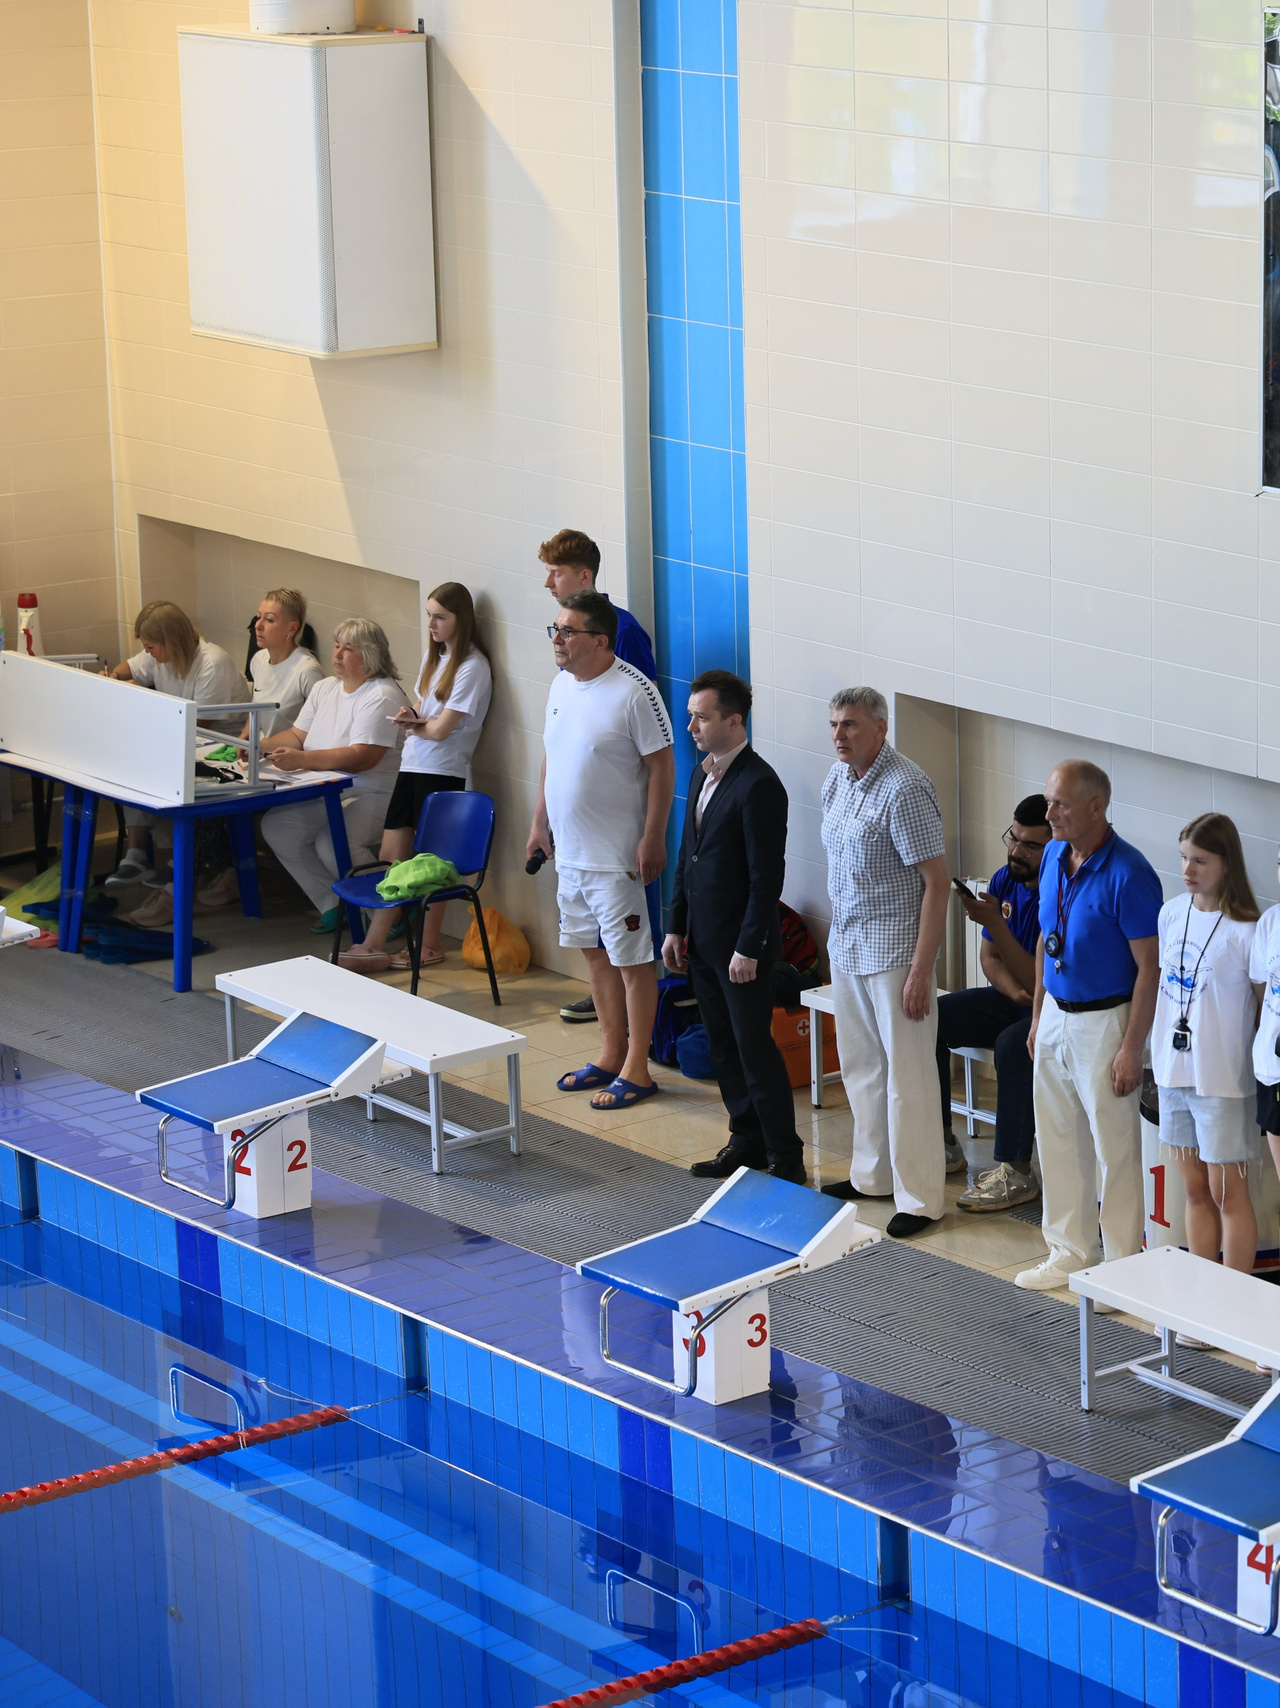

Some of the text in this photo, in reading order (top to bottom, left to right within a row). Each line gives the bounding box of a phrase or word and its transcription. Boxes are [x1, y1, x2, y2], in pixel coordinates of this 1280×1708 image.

[231, 1129, 251, 1176] 2
[287, 1140, 308, 1172] 2
[1149, 1165, 1170, 1228] 1
[682, 1310, 706, 1358] 3
[747, 1313, 767, 1348] 3
[1247, 1542, 1274, 1585] 4
